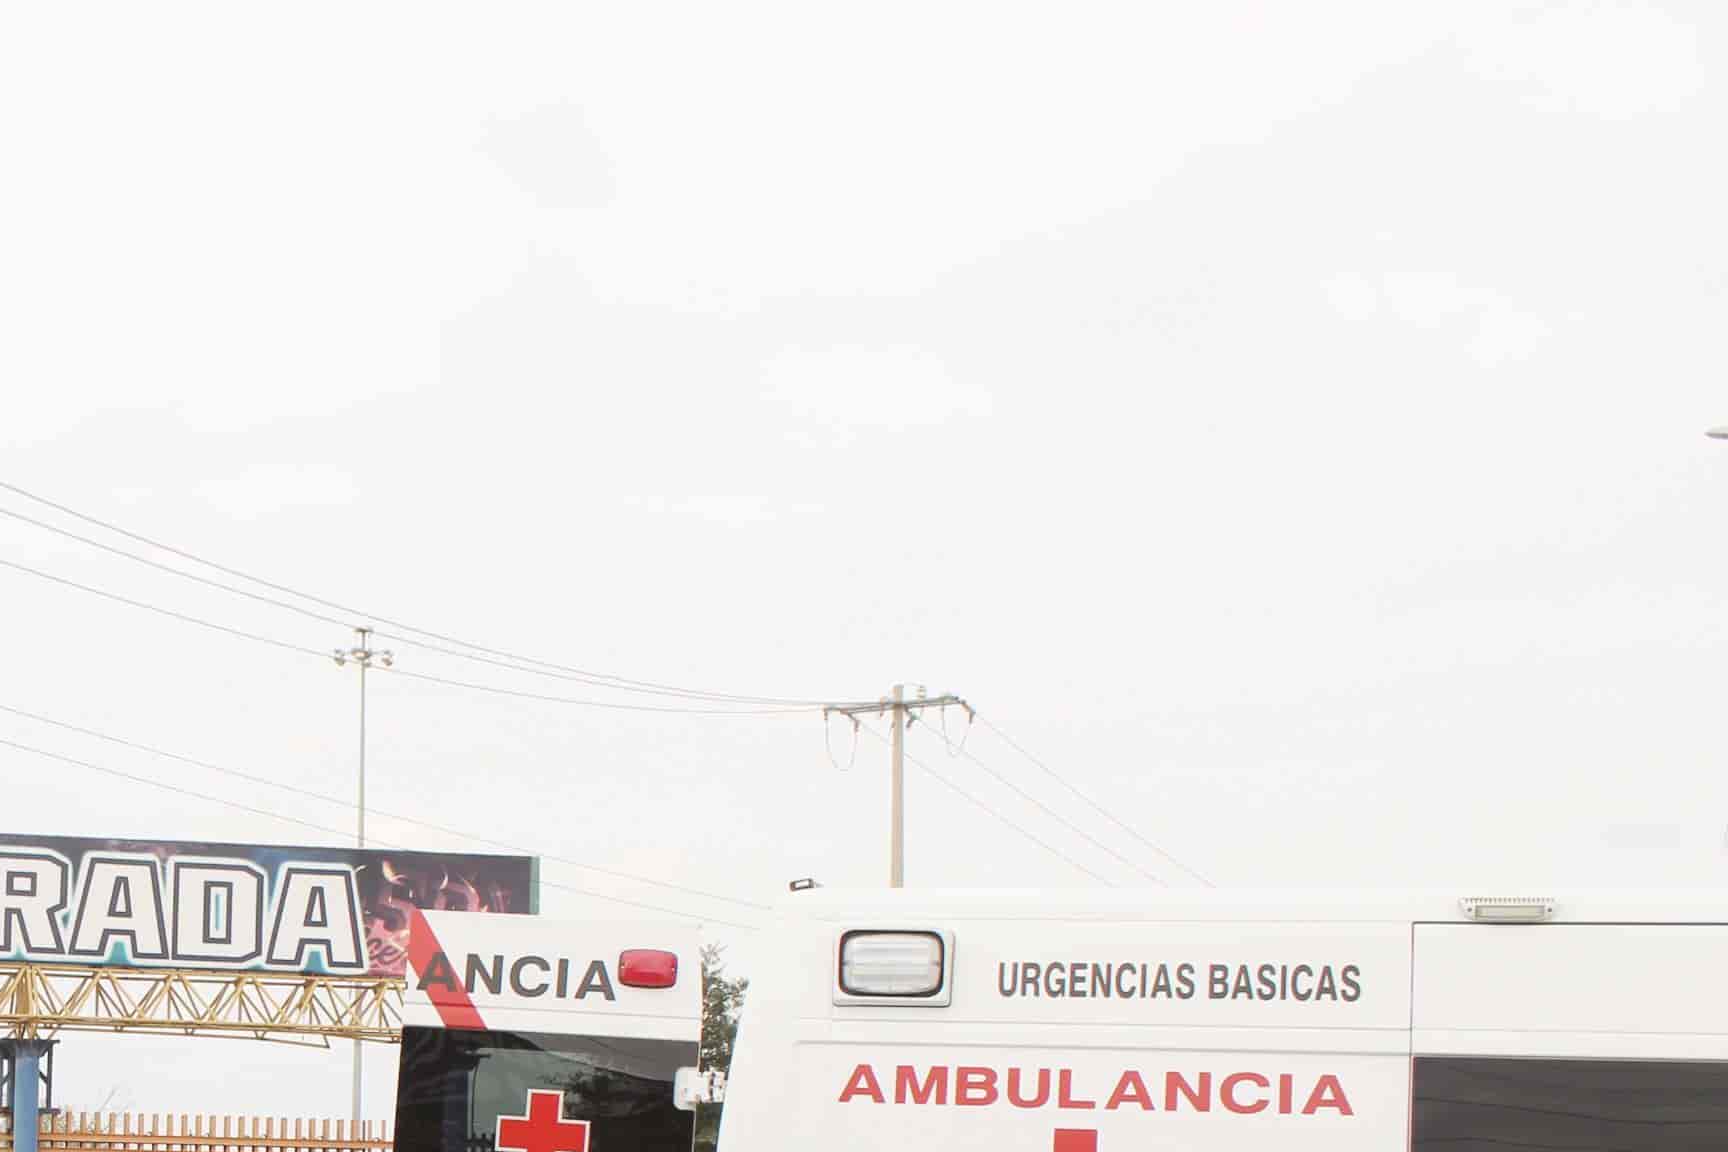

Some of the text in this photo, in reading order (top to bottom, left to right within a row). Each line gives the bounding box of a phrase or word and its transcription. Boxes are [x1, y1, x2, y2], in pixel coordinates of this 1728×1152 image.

[417, 952, 617, 1002] ANCIA
[997, 960, 1362, 1003] URGENCIAS BASICAS
[837, 1063, 1355, 1116] AMBULANCIA
